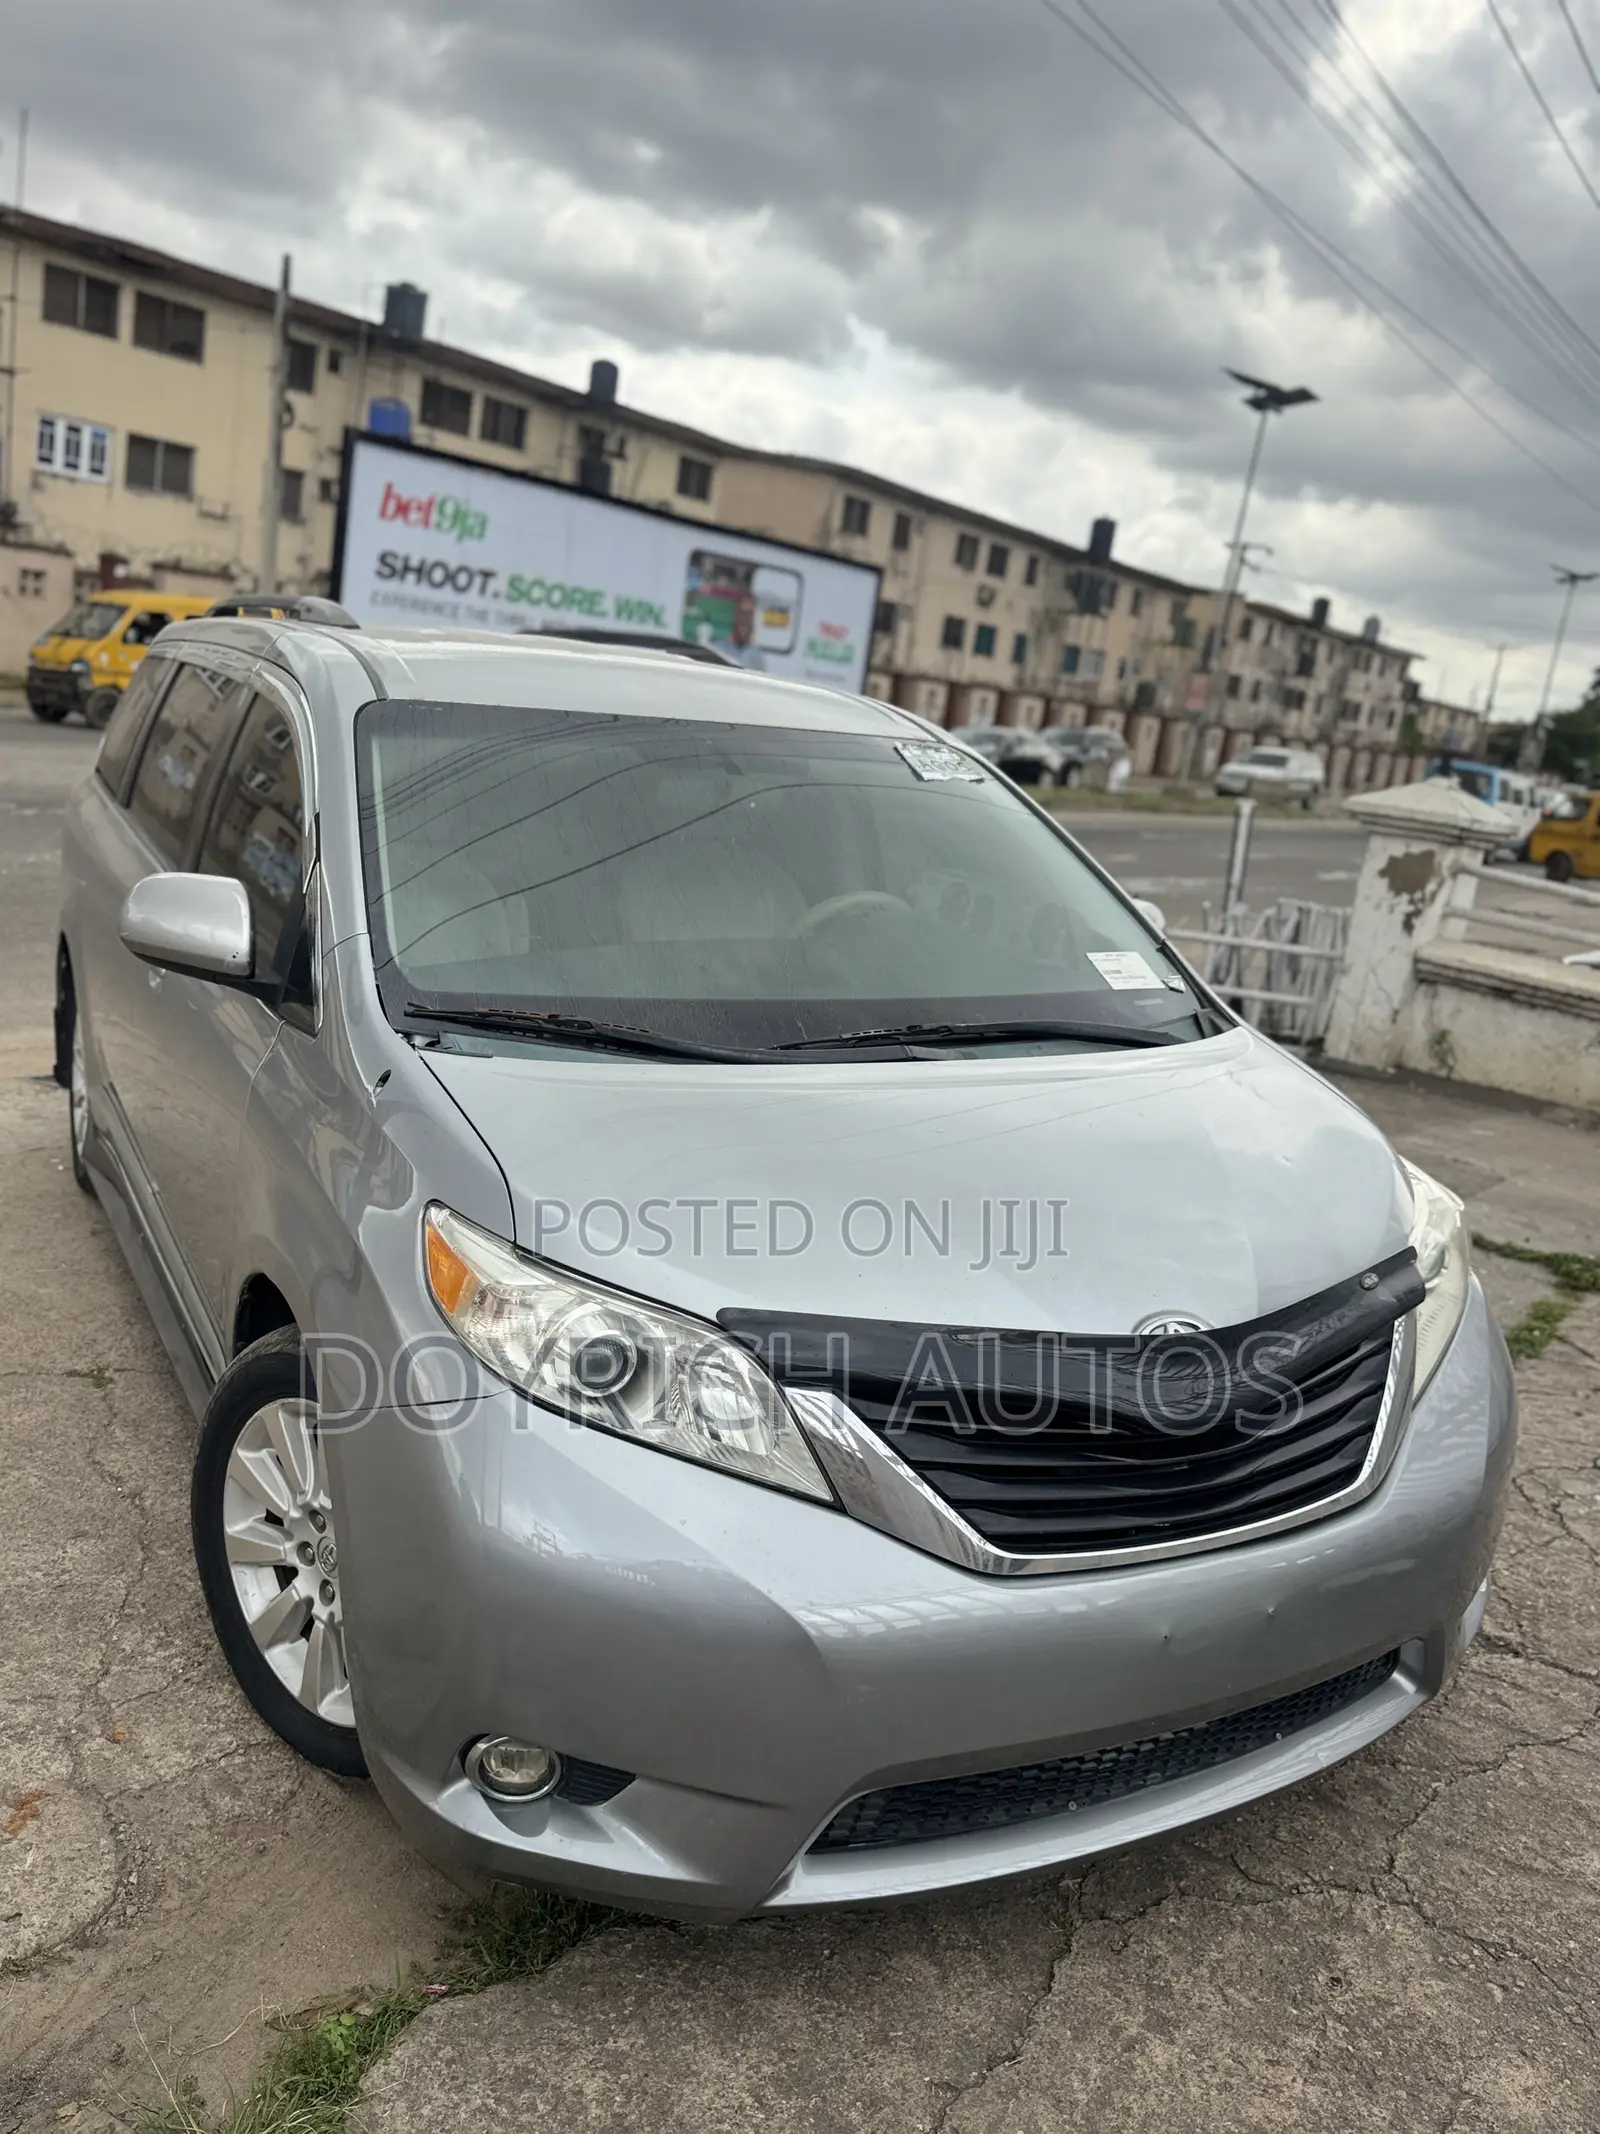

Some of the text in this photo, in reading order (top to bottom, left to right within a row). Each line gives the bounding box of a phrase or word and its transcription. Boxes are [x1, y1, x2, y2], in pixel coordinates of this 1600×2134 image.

[379, 480, 487, 542] bet9ja
[375, 549, 502, 598] SHOOT.
[504, 572, 609, 618] SCORE.
